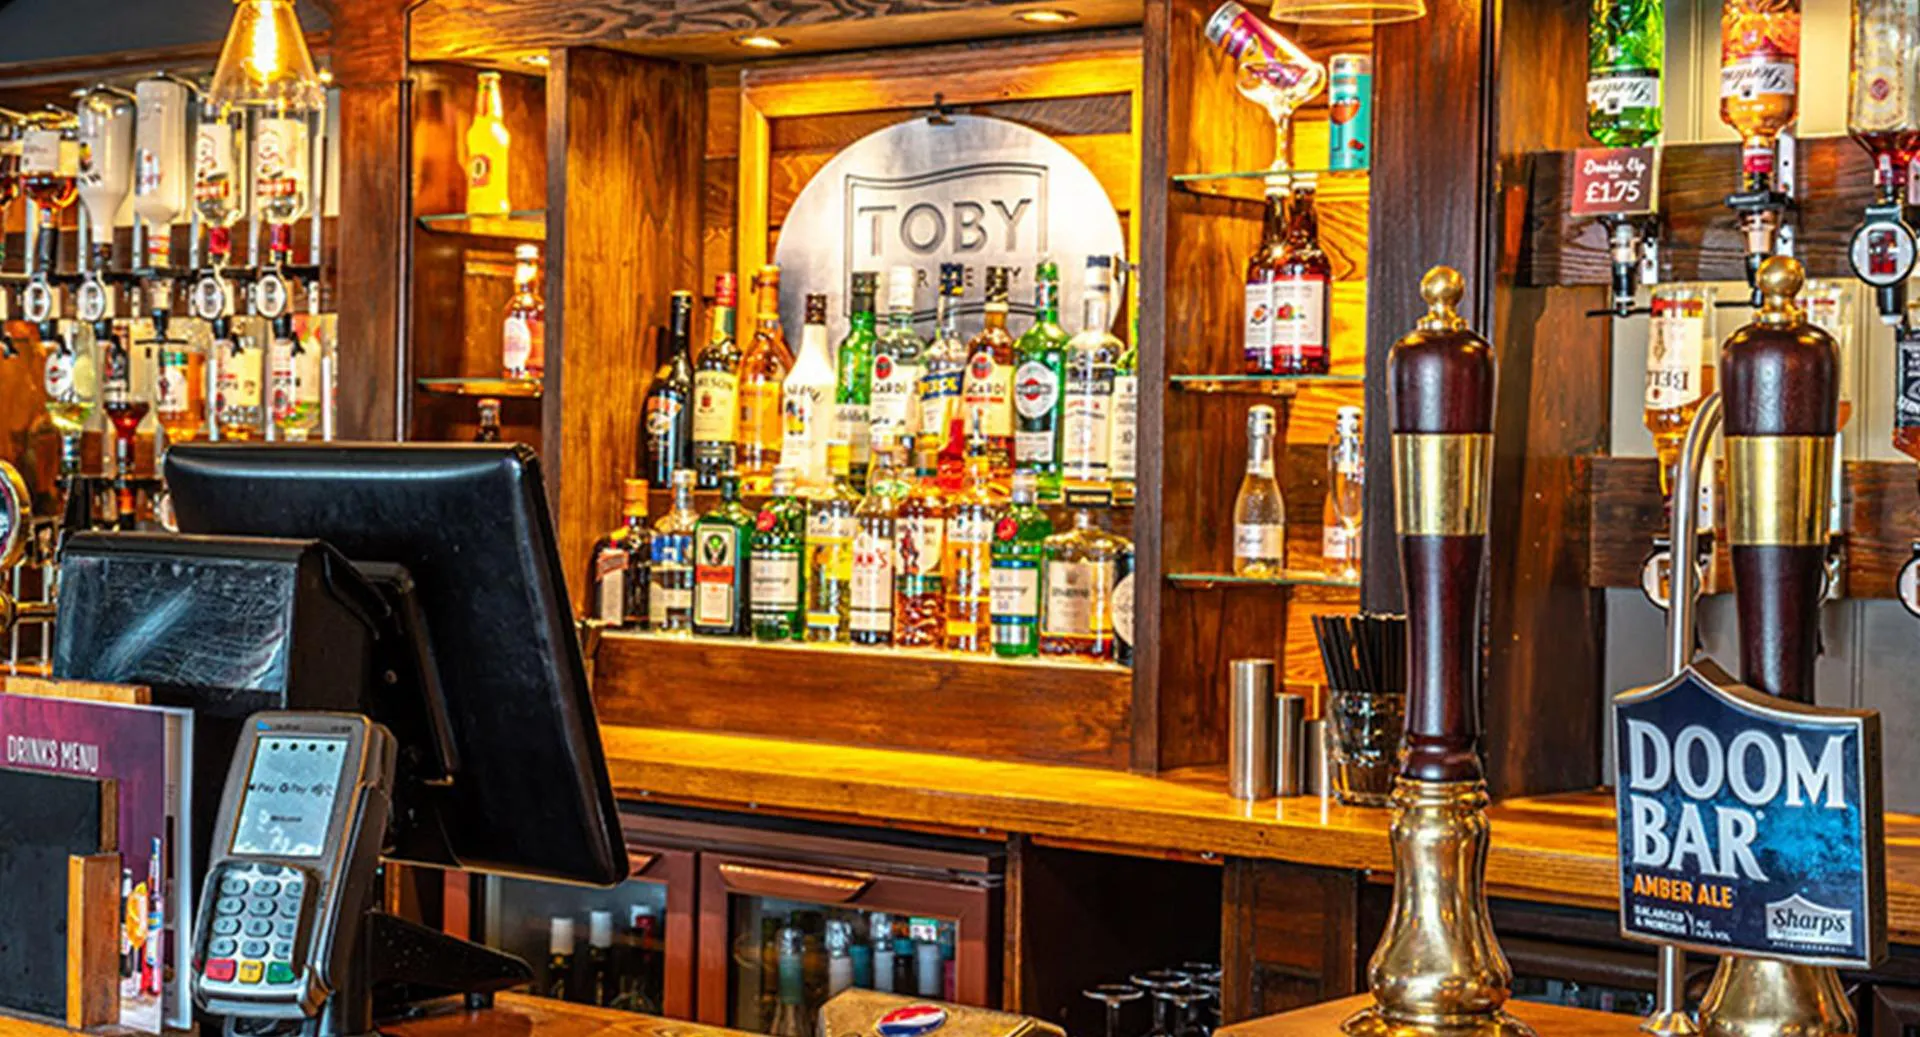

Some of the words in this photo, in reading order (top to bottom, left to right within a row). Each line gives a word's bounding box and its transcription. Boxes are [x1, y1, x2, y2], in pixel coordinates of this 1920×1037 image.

[1583, 158, 1624, 176] Double
[1626, 156, 1647, 178] Up
[1584, 181, 1640, 202] £1.75
[858, 198, 1033, 257] TOBY
[7, 734, 58, 768] DRINKS
[60, 741, 99, 773] MENU
[1626, 719, 1848, 809] DOOM
[1632, 873, 1694, 904] AMBER
[1696, 883, 1734, 909] ALE
[1772, 908, 1846, 936] Sharp's
